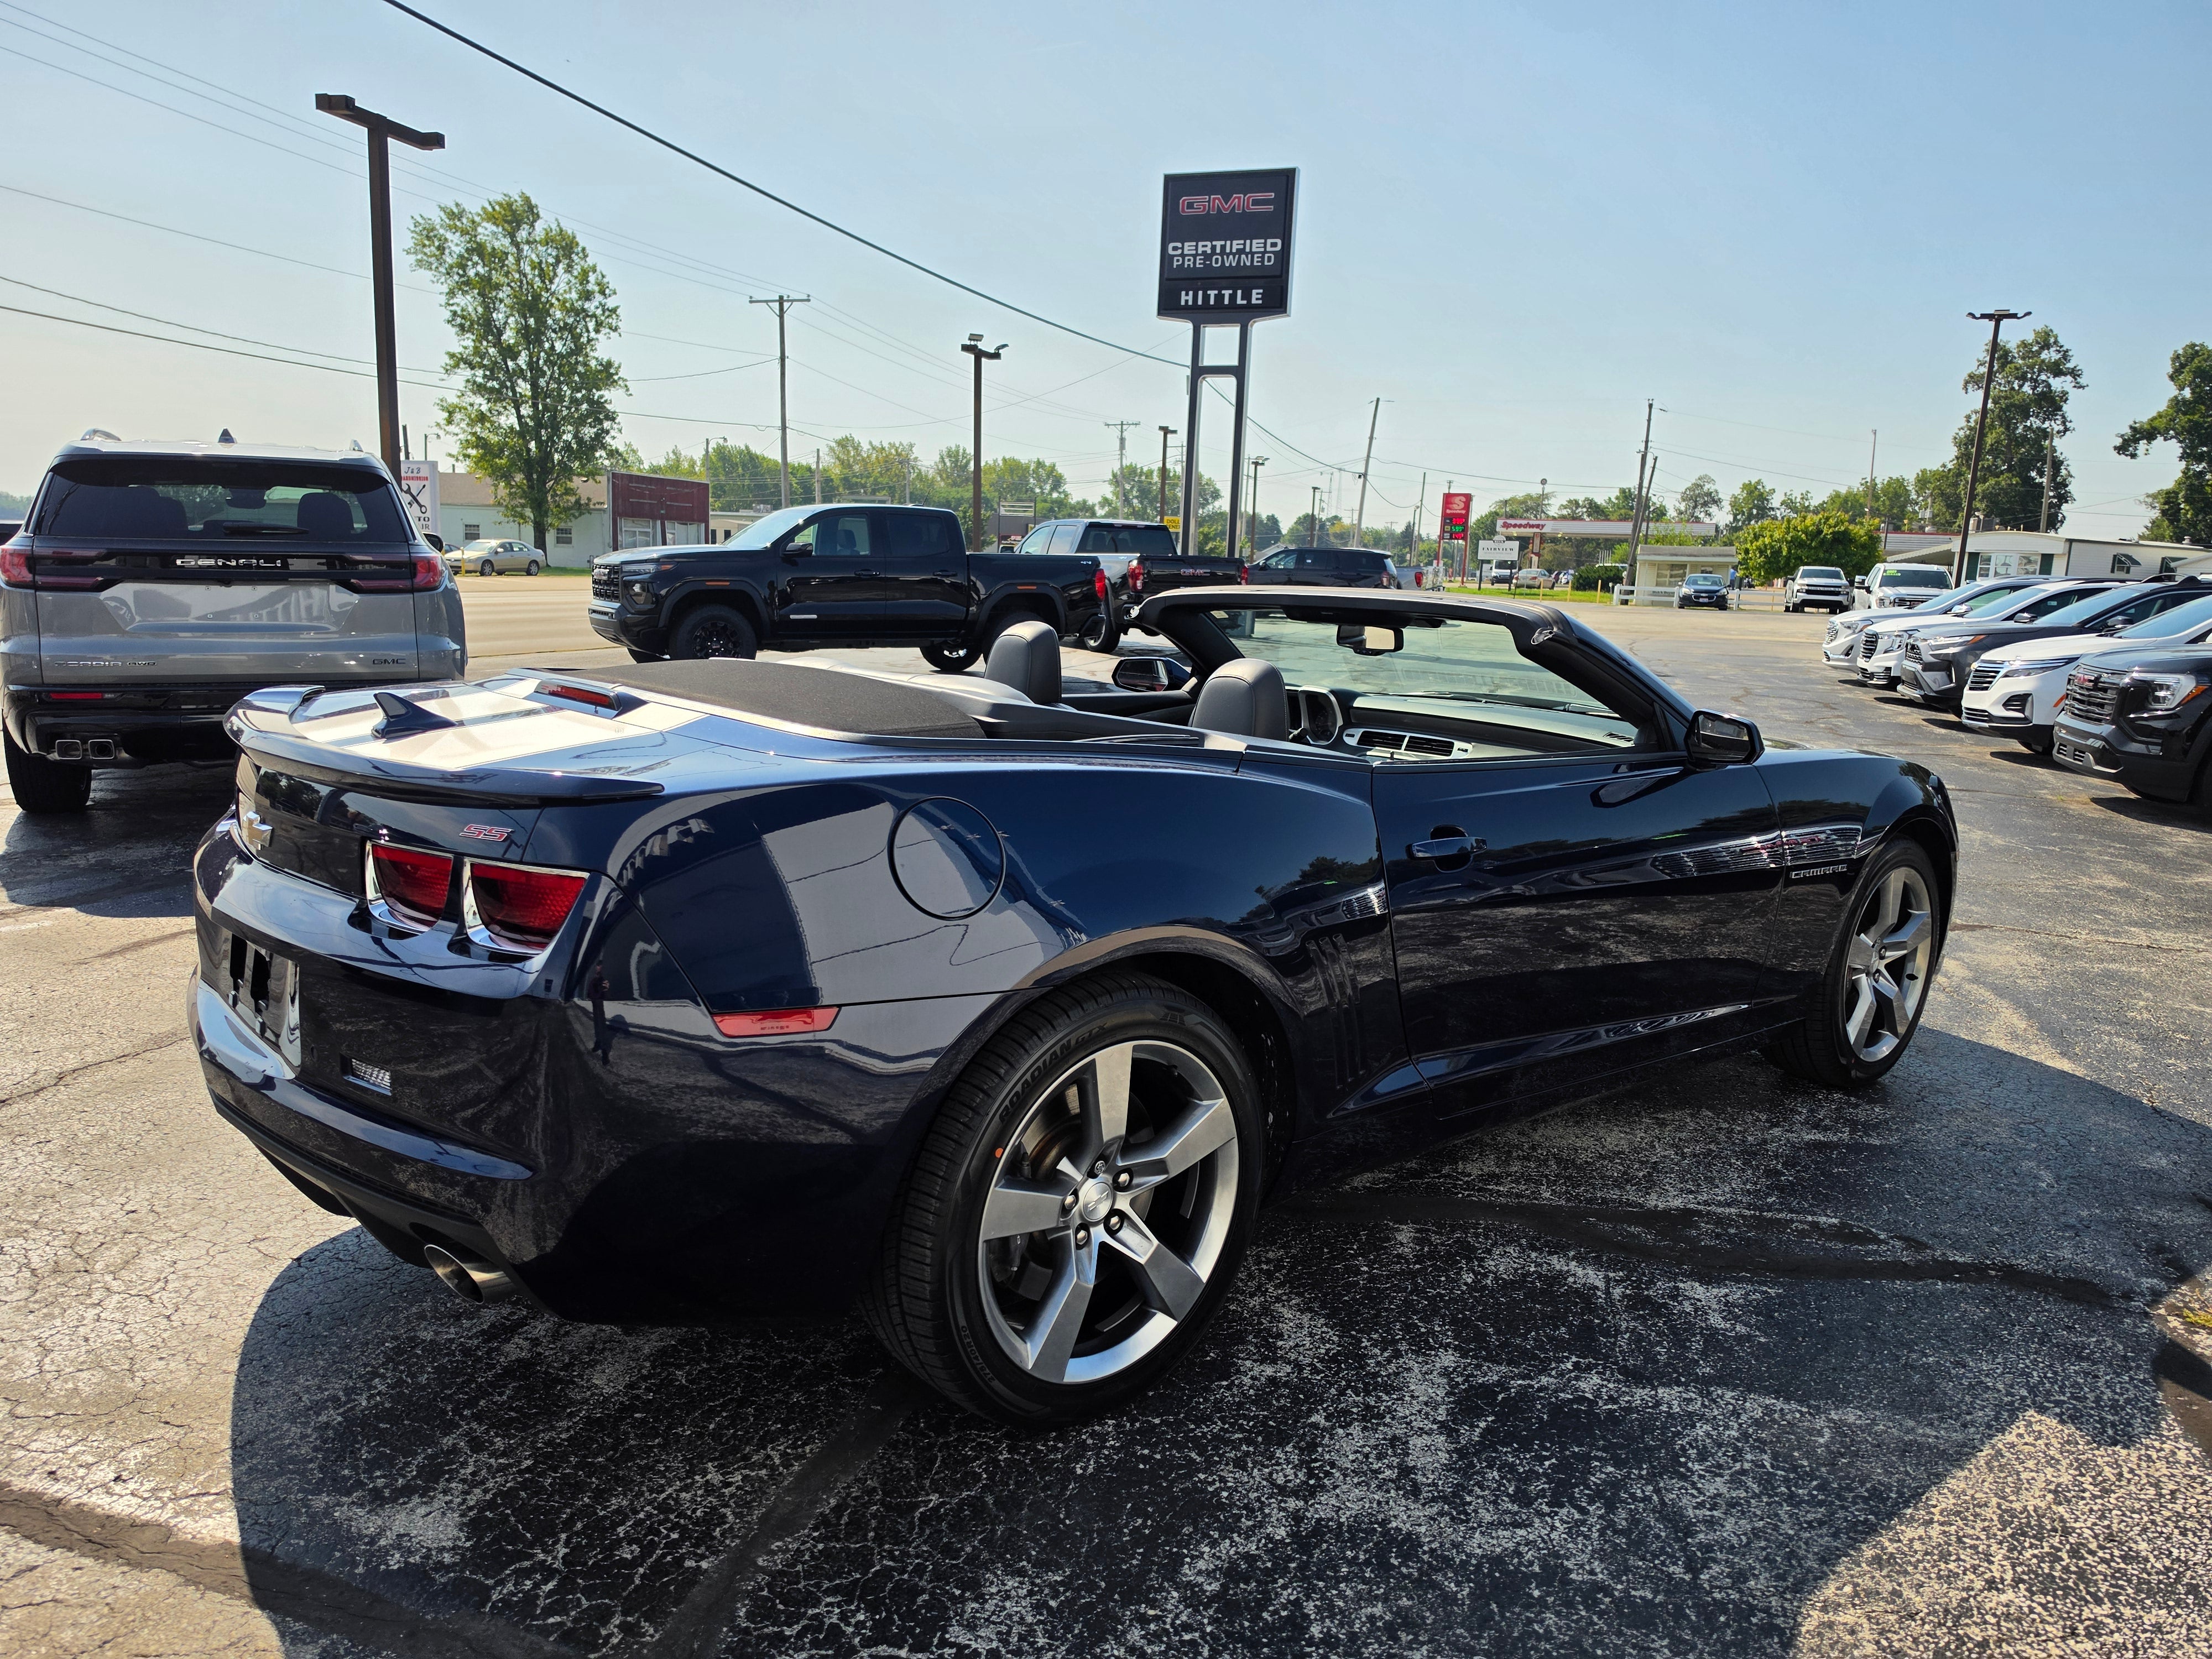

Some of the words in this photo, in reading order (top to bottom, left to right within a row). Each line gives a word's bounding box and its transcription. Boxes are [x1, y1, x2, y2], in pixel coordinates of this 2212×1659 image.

[1180, 193, 1275, 215] GMC
[1168, 239, 1282, 255] CERTIFIED
[1173, 253, 1275, 268] PRE-OWNED
[1181, 289, 1264, 305] HITTLE
[1500, 521, 1546, 530] Speedway
[176, 559, 281, 567] DENALI
[459, 824, 514, 841] SS
[1791, 864, 1848, 878] CAMARO
[998, 1040, 1072, 1124] ROADIAN
[1075, 1022, 1108, 1045] GTX
[961, 1325, 996, 1383] 275/40R20
